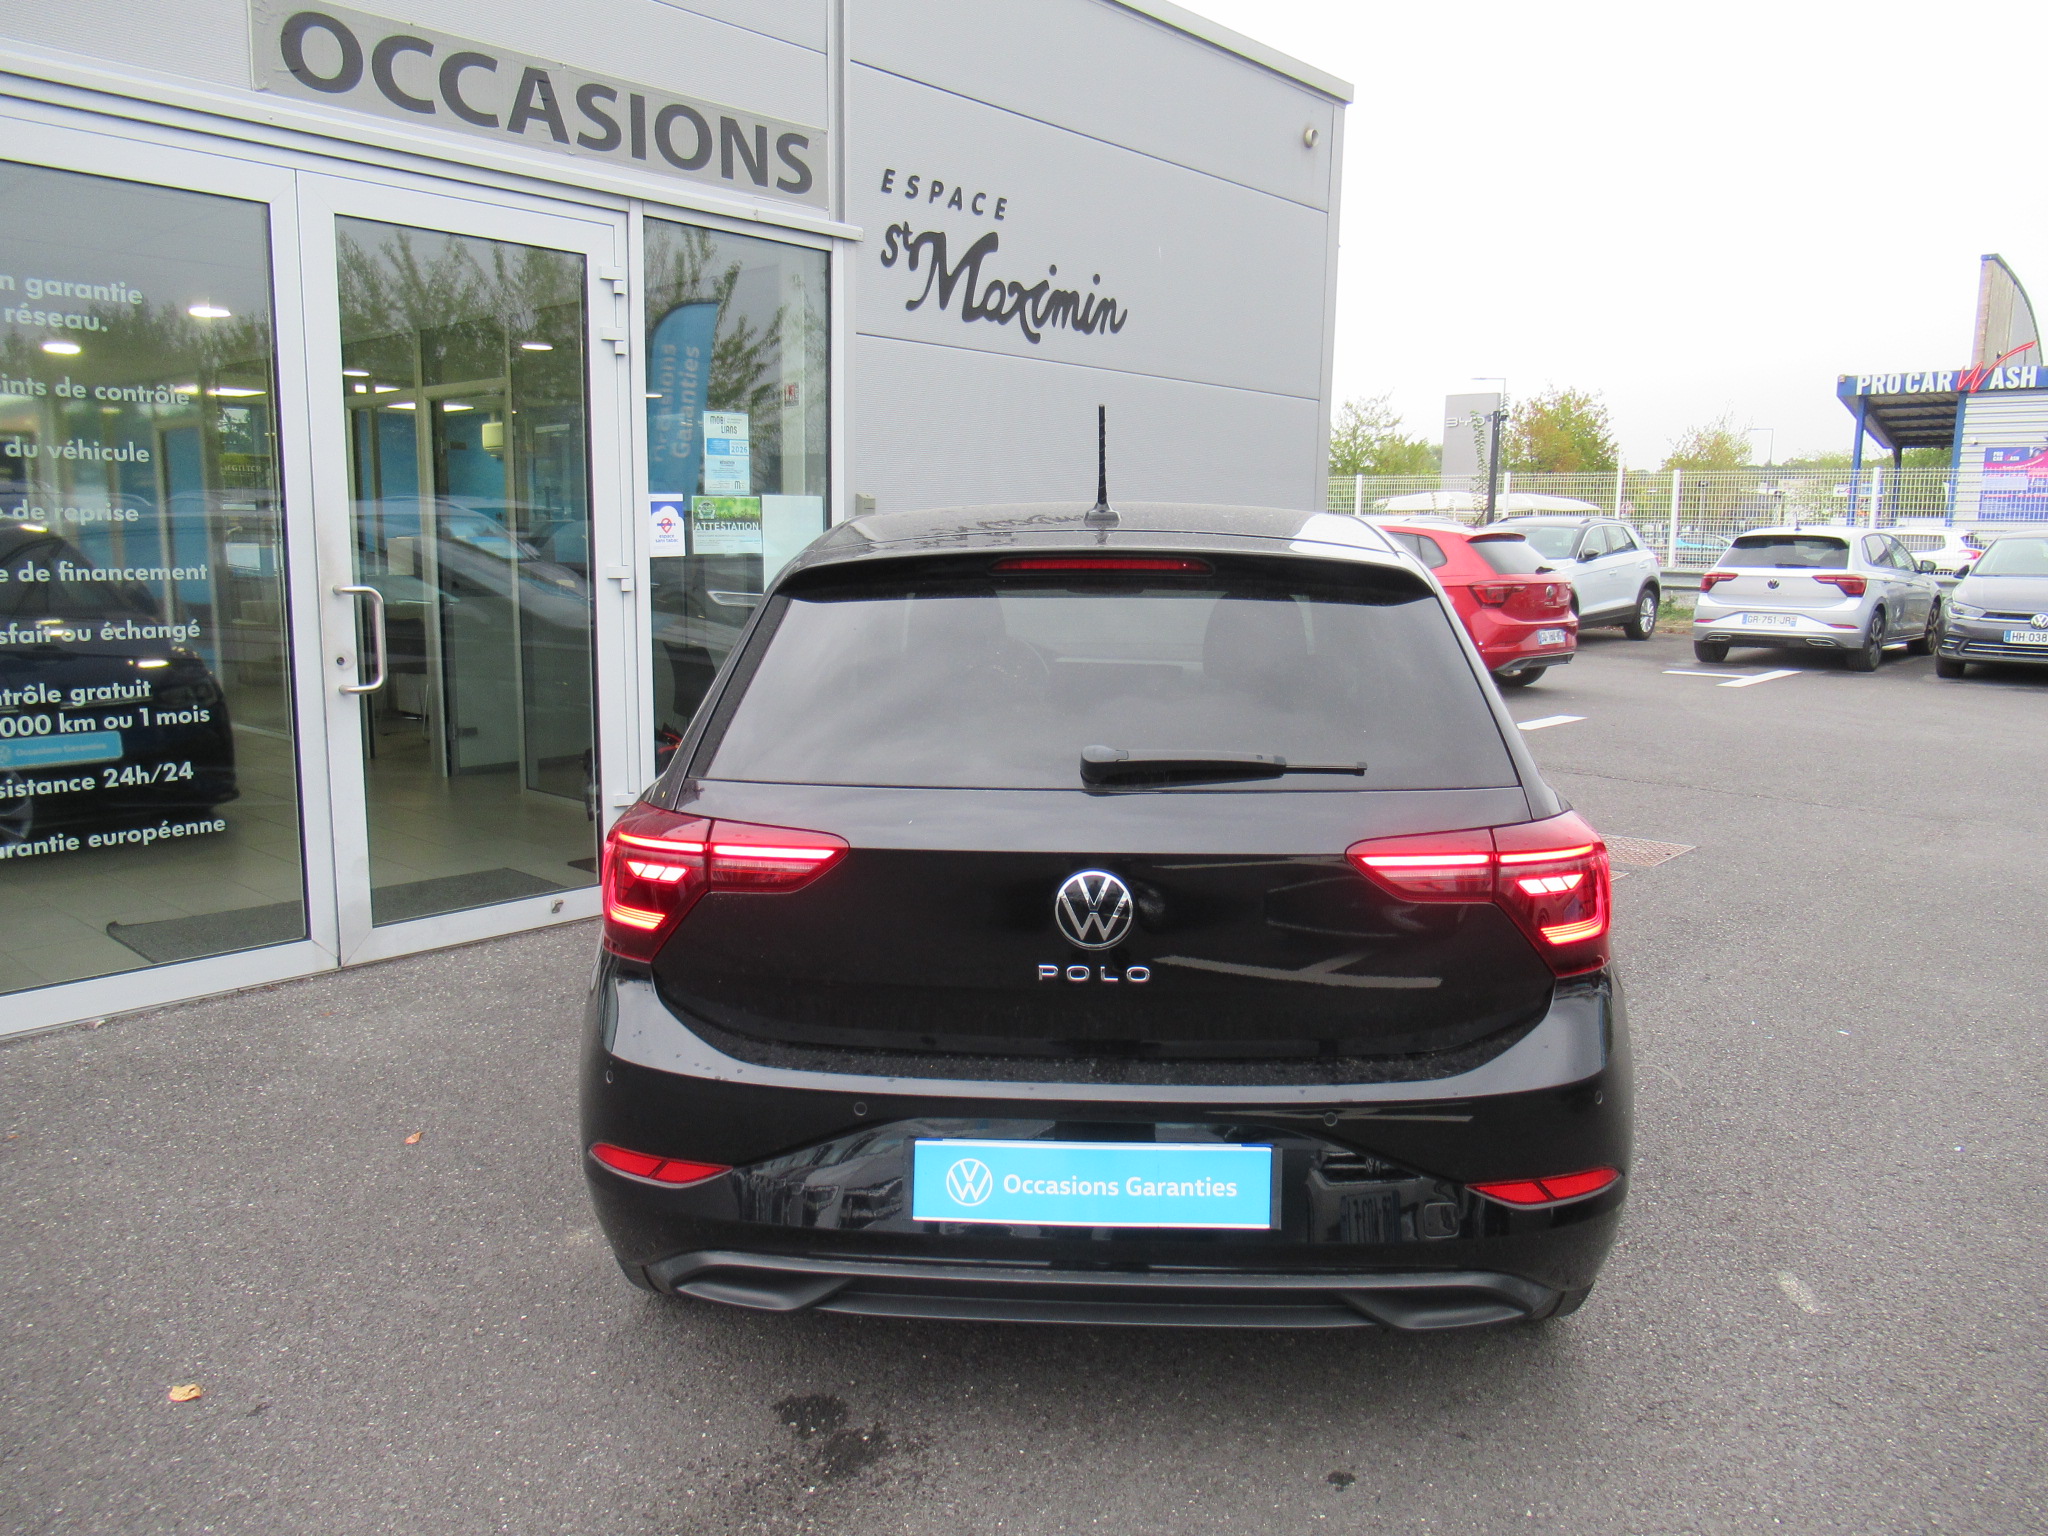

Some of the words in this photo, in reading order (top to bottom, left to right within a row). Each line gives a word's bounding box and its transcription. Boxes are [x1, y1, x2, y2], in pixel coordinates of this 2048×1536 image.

[280, 11, 813, 194] OCCASIONS
[881, 168, 1008, 221] ESPACE
[25, 277, 144, 305] garantie
[881, 221, 913, 268] St
[905, 231, 1128, 345] Maximin
[4, 302, 108, 332] réseau.
[1856, 374, 1901, 396] PRO
[1905, 371, 1953, 394] CAR
[1956, 350, 2038, 393] WASH
[0, 373, 47, 396] ints
[55, 377, 87, 398] de
[95, 384, 190, 406] contrôle
[5, 436, 38, 458] du
[47, 439, 150, 463] véhicule
[12, 499, 45, 520] de
[55, 504, 139, 525] reprise
[694, 521, 760, 531] ATTESTATION
[18, 561, 50, 582] de
[59, 562, 208, 582] financement
[0, 622, 51, 645] sfait
[61, 628, 91, 642] ou
[100, 619, 201, 643] échangé
[0, 683, 61, 706] trôle
[70, 679, 152, 706] gratuit
[59, 712, 96, 733] km
[104, 714, 132, 730] ou
[139, 708, 149, 728] 1
[156, 705, 210, 726] mois
[103, 761, 194, 788] 24h/24
[88, 818, 226, 846] européenne
[1038, 964, 1150, 983] POLO
[1003, 1174, 1119, 1197] Occasions
[1125, 1176, 1238, 1198] Garanties
